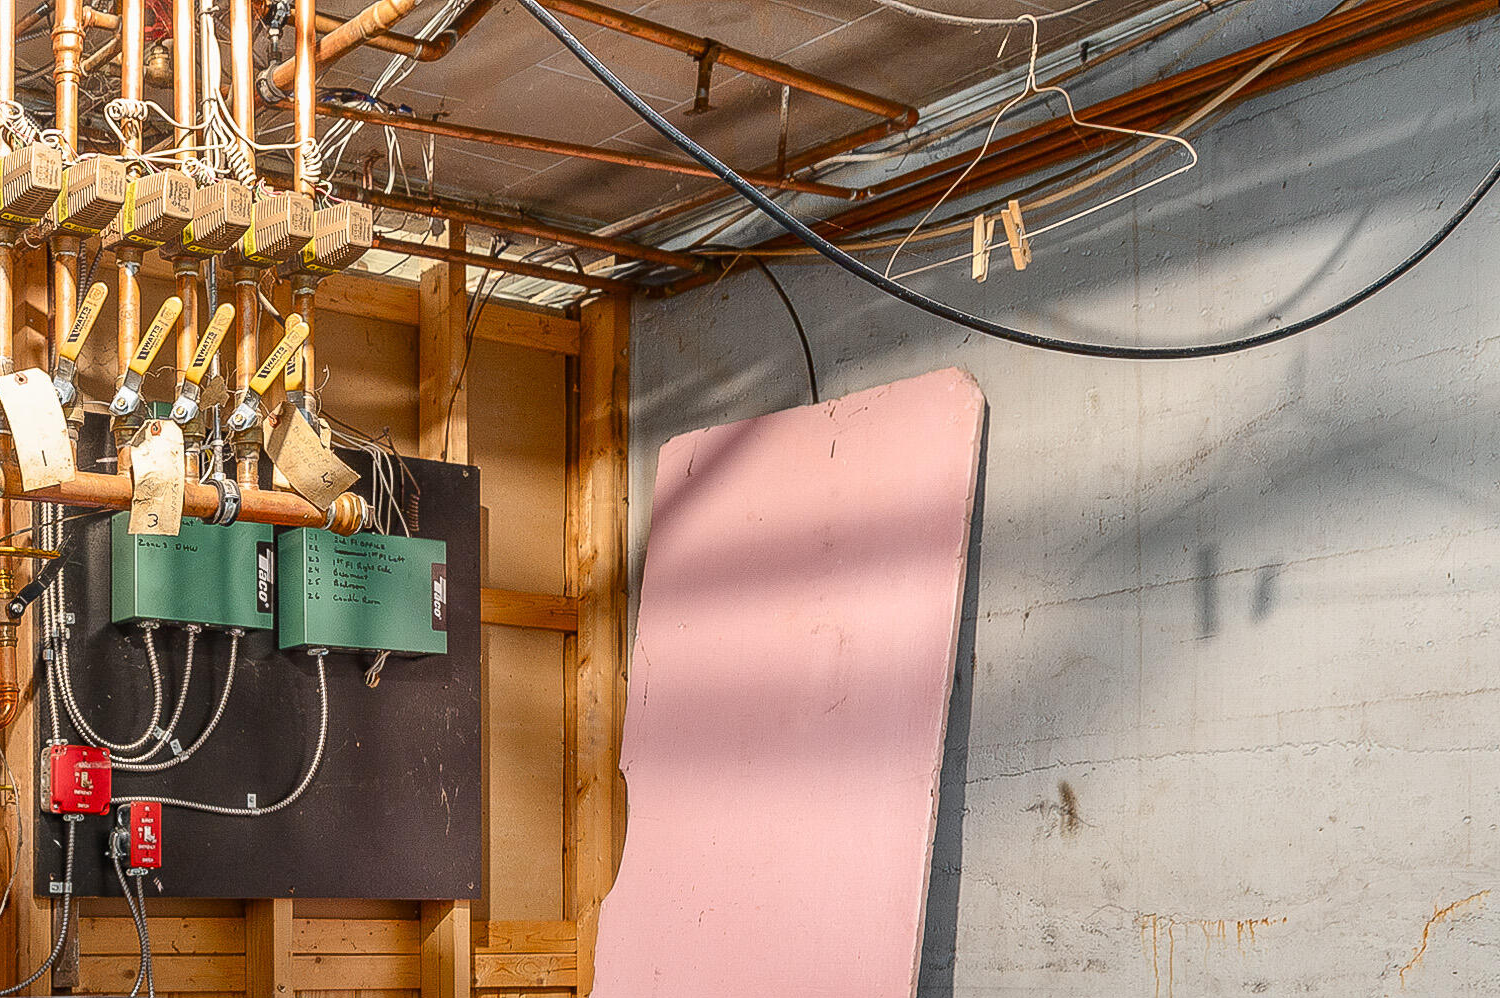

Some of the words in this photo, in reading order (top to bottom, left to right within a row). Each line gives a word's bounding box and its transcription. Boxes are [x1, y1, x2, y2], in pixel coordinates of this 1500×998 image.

[71, 306, 89, 335] WATTS
[140, 324, 160, 354] WATTS
[196, 331, 214, 361] WATTS
[262, 347, 285, 374] WATTS
[147, 513, 159, 528] 3
[175, 543, 198, 552] DHW
[258, 548, 273, 603] Taco
[433, 576, 447, 617] Taco
